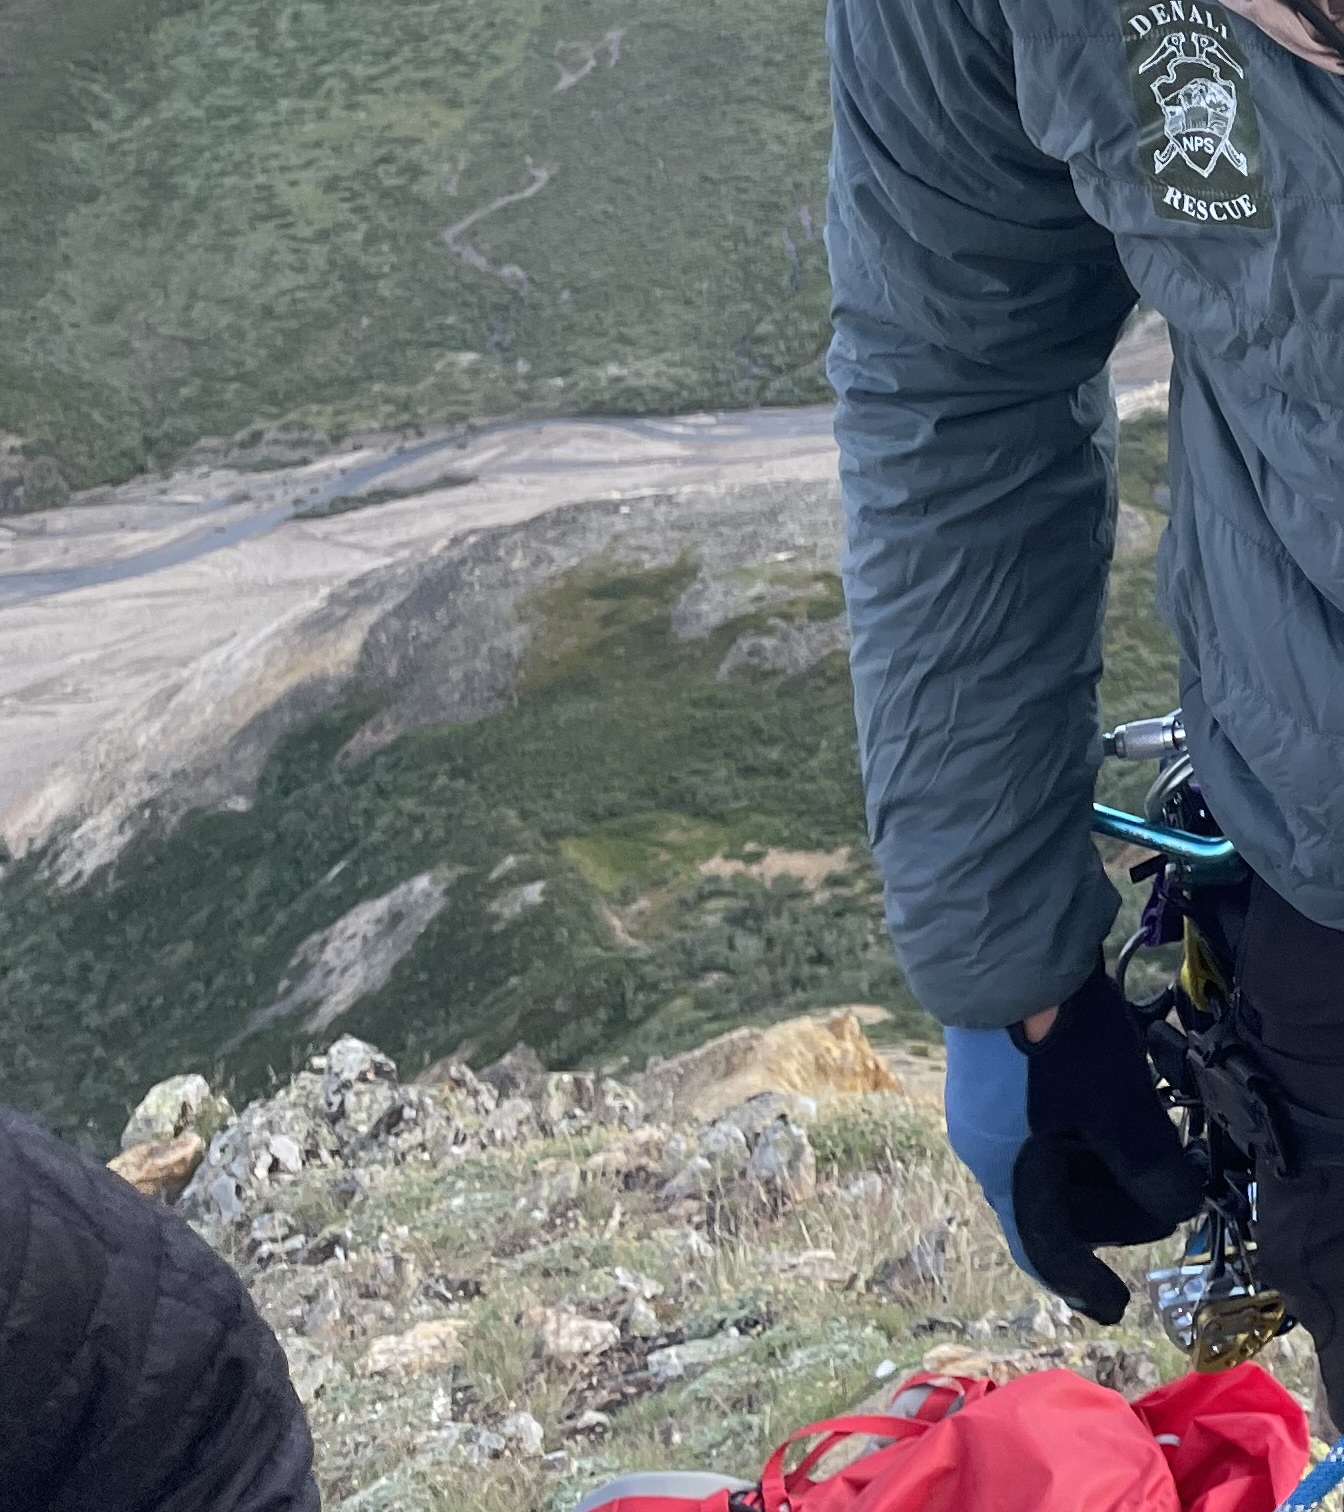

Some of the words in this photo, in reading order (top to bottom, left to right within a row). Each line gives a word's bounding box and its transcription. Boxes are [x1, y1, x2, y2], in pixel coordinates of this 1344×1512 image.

[1128, 0, 1228, 39] DENALI
[1182, 135, 1215, 155] NPS
[1162, 184, 1258, 222] RESCUE
